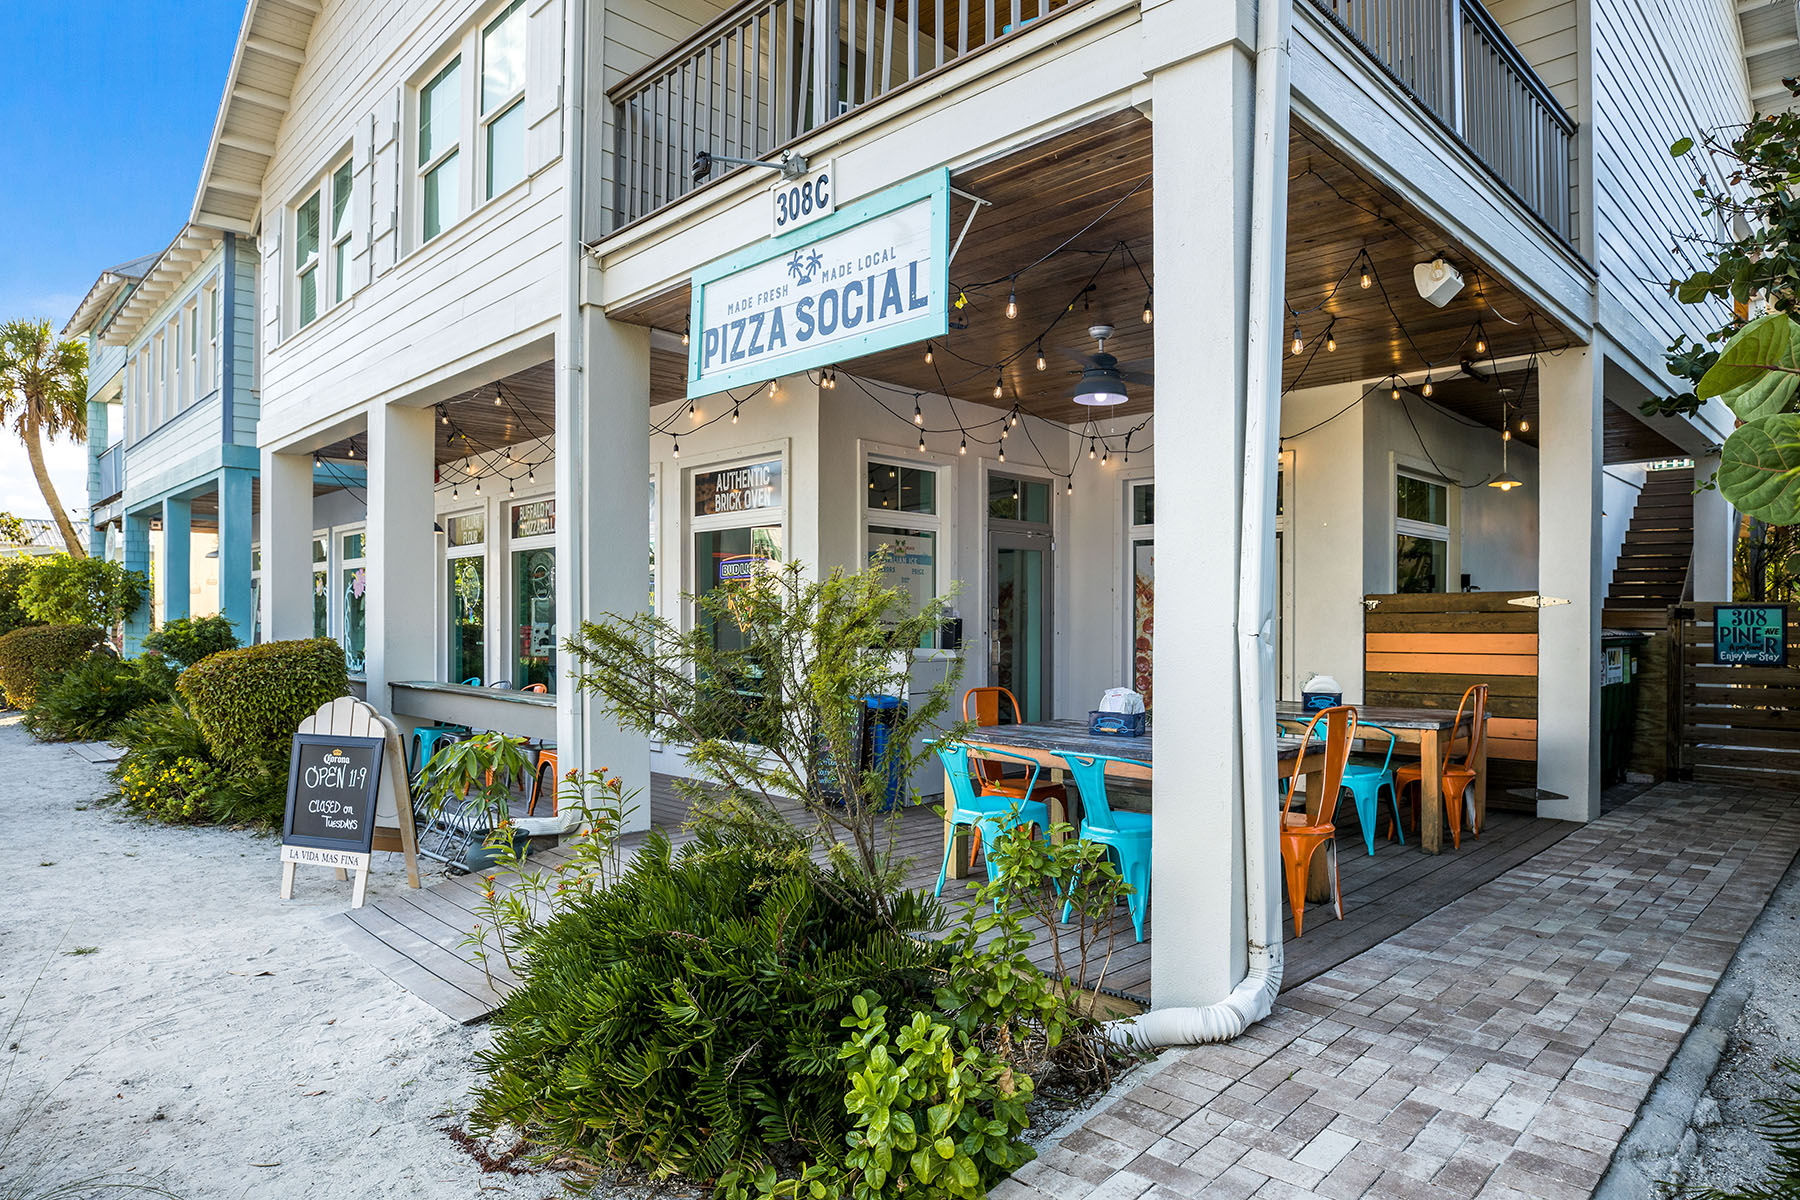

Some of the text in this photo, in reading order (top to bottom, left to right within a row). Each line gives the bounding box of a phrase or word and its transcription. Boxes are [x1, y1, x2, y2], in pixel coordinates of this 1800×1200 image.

[776, 174, 830, 227] 308C
[822, 246, 897, 284] MADE LOCAL
[727, 284, 789, 316] MADE FRESH
[703, 260, 929, 370] PIZZA SOCIAL
[715, 465, 771, 493] AUTHENTIC
[714, 486, 771, 513] BRICK OVEN
[519, 499, 555, 520] BUFFALO MIL
[521, 517, 556, 536] MOZZARELL
[462, 530, 478, 545] FLOUR
[721, 563, 739, 576] BUD
[1731, 608, 1767, 626] 308
[1719, 627, 1762, 643] PINE
[1720, 651, 1780, 662] Enjoy Your Stay
[323, 753, 350, 765] Corona
[305, 764, 367, 790] OPEN 11-9
[308, 800, 341, 814] CLOSED
[289, 849, 359, 866] LA VIDA MAS FINA
